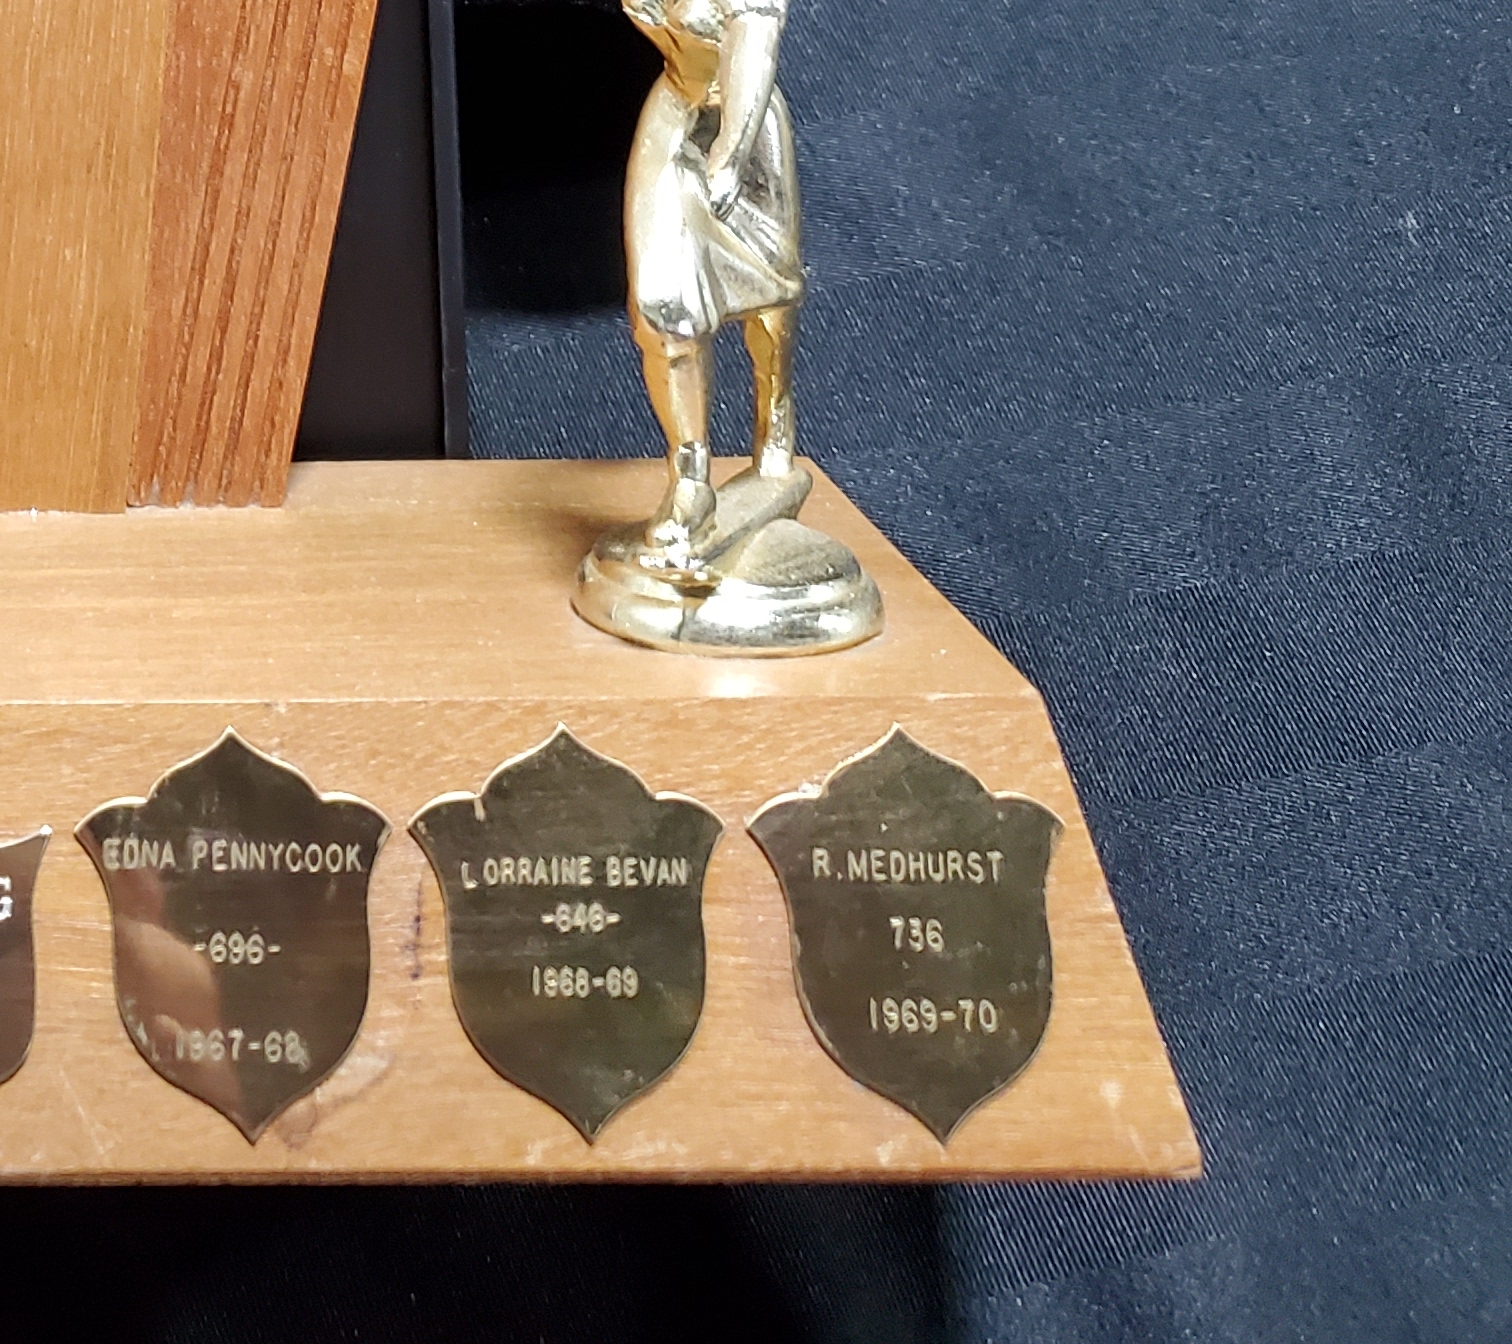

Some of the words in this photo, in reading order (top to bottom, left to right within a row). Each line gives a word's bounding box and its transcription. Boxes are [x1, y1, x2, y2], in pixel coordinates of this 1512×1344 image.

[102, 837, 176, 869] EDNA
[192, 838, 362, 872] PENNYCOOK
[462, 855, 593, 889] LORRAINE
[605, 855, 687, 888] BEVAN
[889, 915, 944, 953] 736
[532, 965, 639, 998] 1968-69
[869, 997, 999, 1034] 1969-70
[175, 1028, 300, 1064] 1967-68
